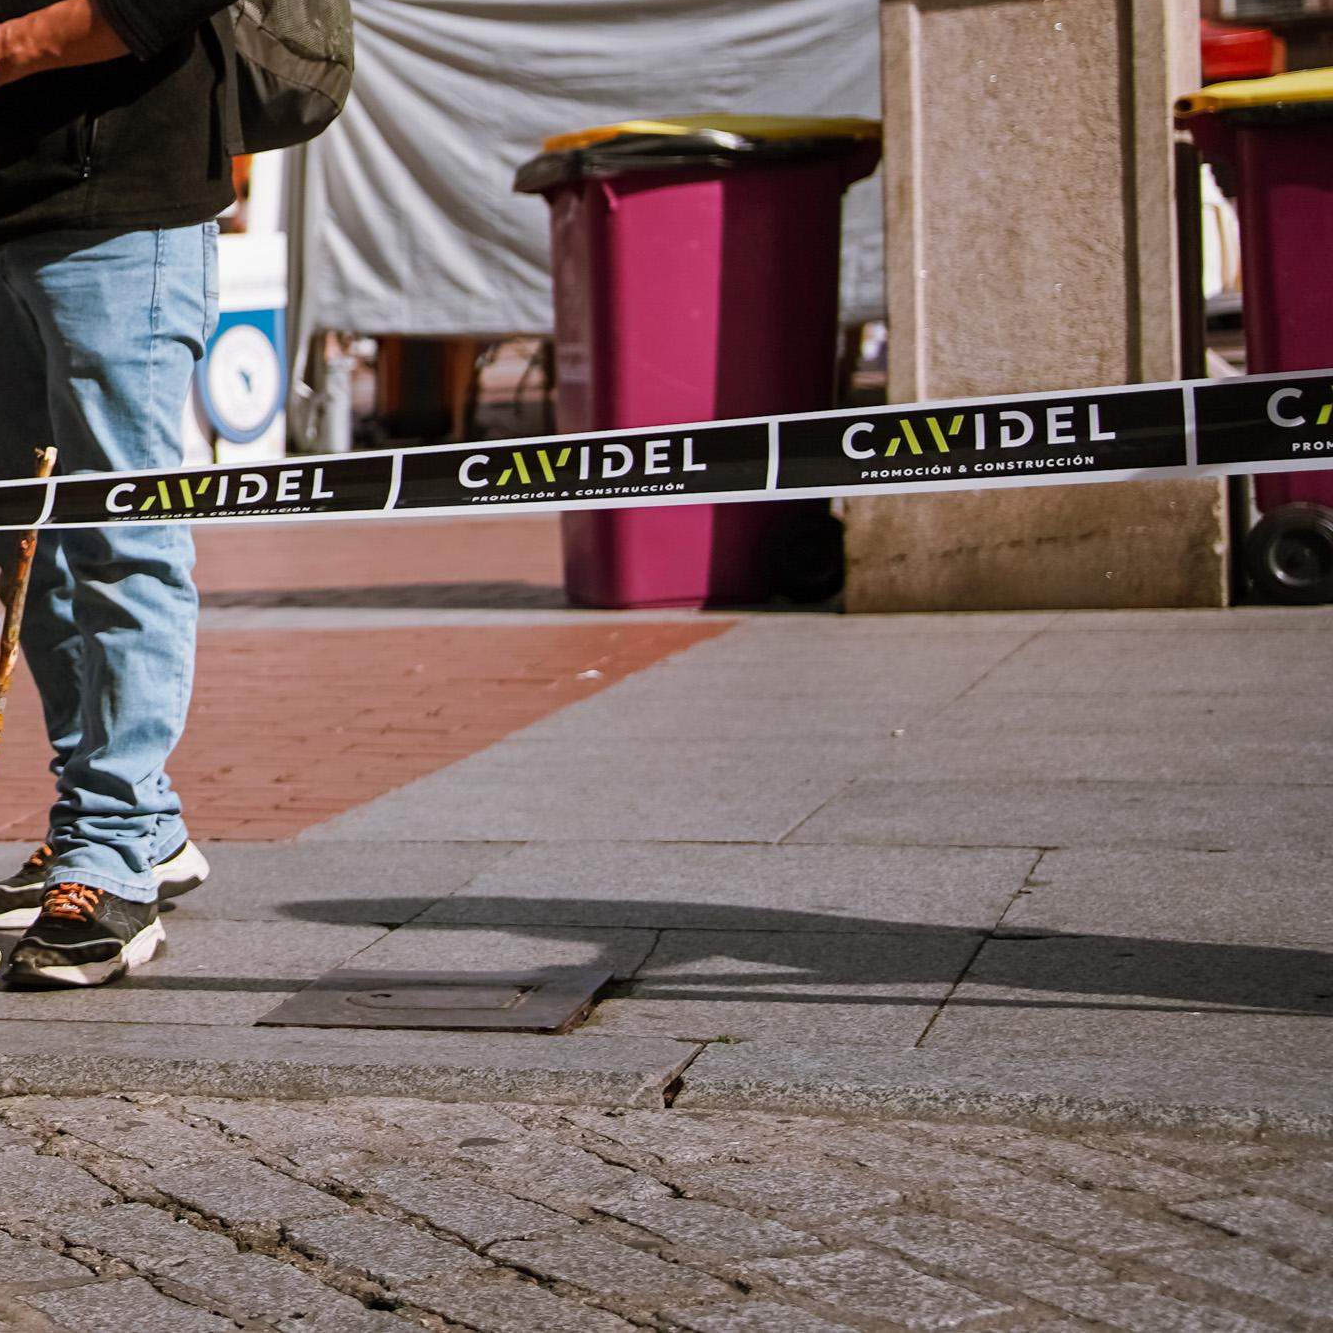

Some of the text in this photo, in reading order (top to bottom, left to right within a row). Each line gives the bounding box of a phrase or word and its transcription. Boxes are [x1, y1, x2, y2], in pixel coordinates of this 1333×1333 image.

[842, 403, 1117, 461] CAVIDEL
[458, 437, 708, 490] CAVIDEL
[861, 455, 1095, 480] PROMOCIÓN & CONSTRUCCIÓN
[105, 468, 334, 514] CAVIDEL
[471, 491, 555, 503] PROMOCIÓN
[575, 482, 685, 497] CONSTRUCCIÓN
